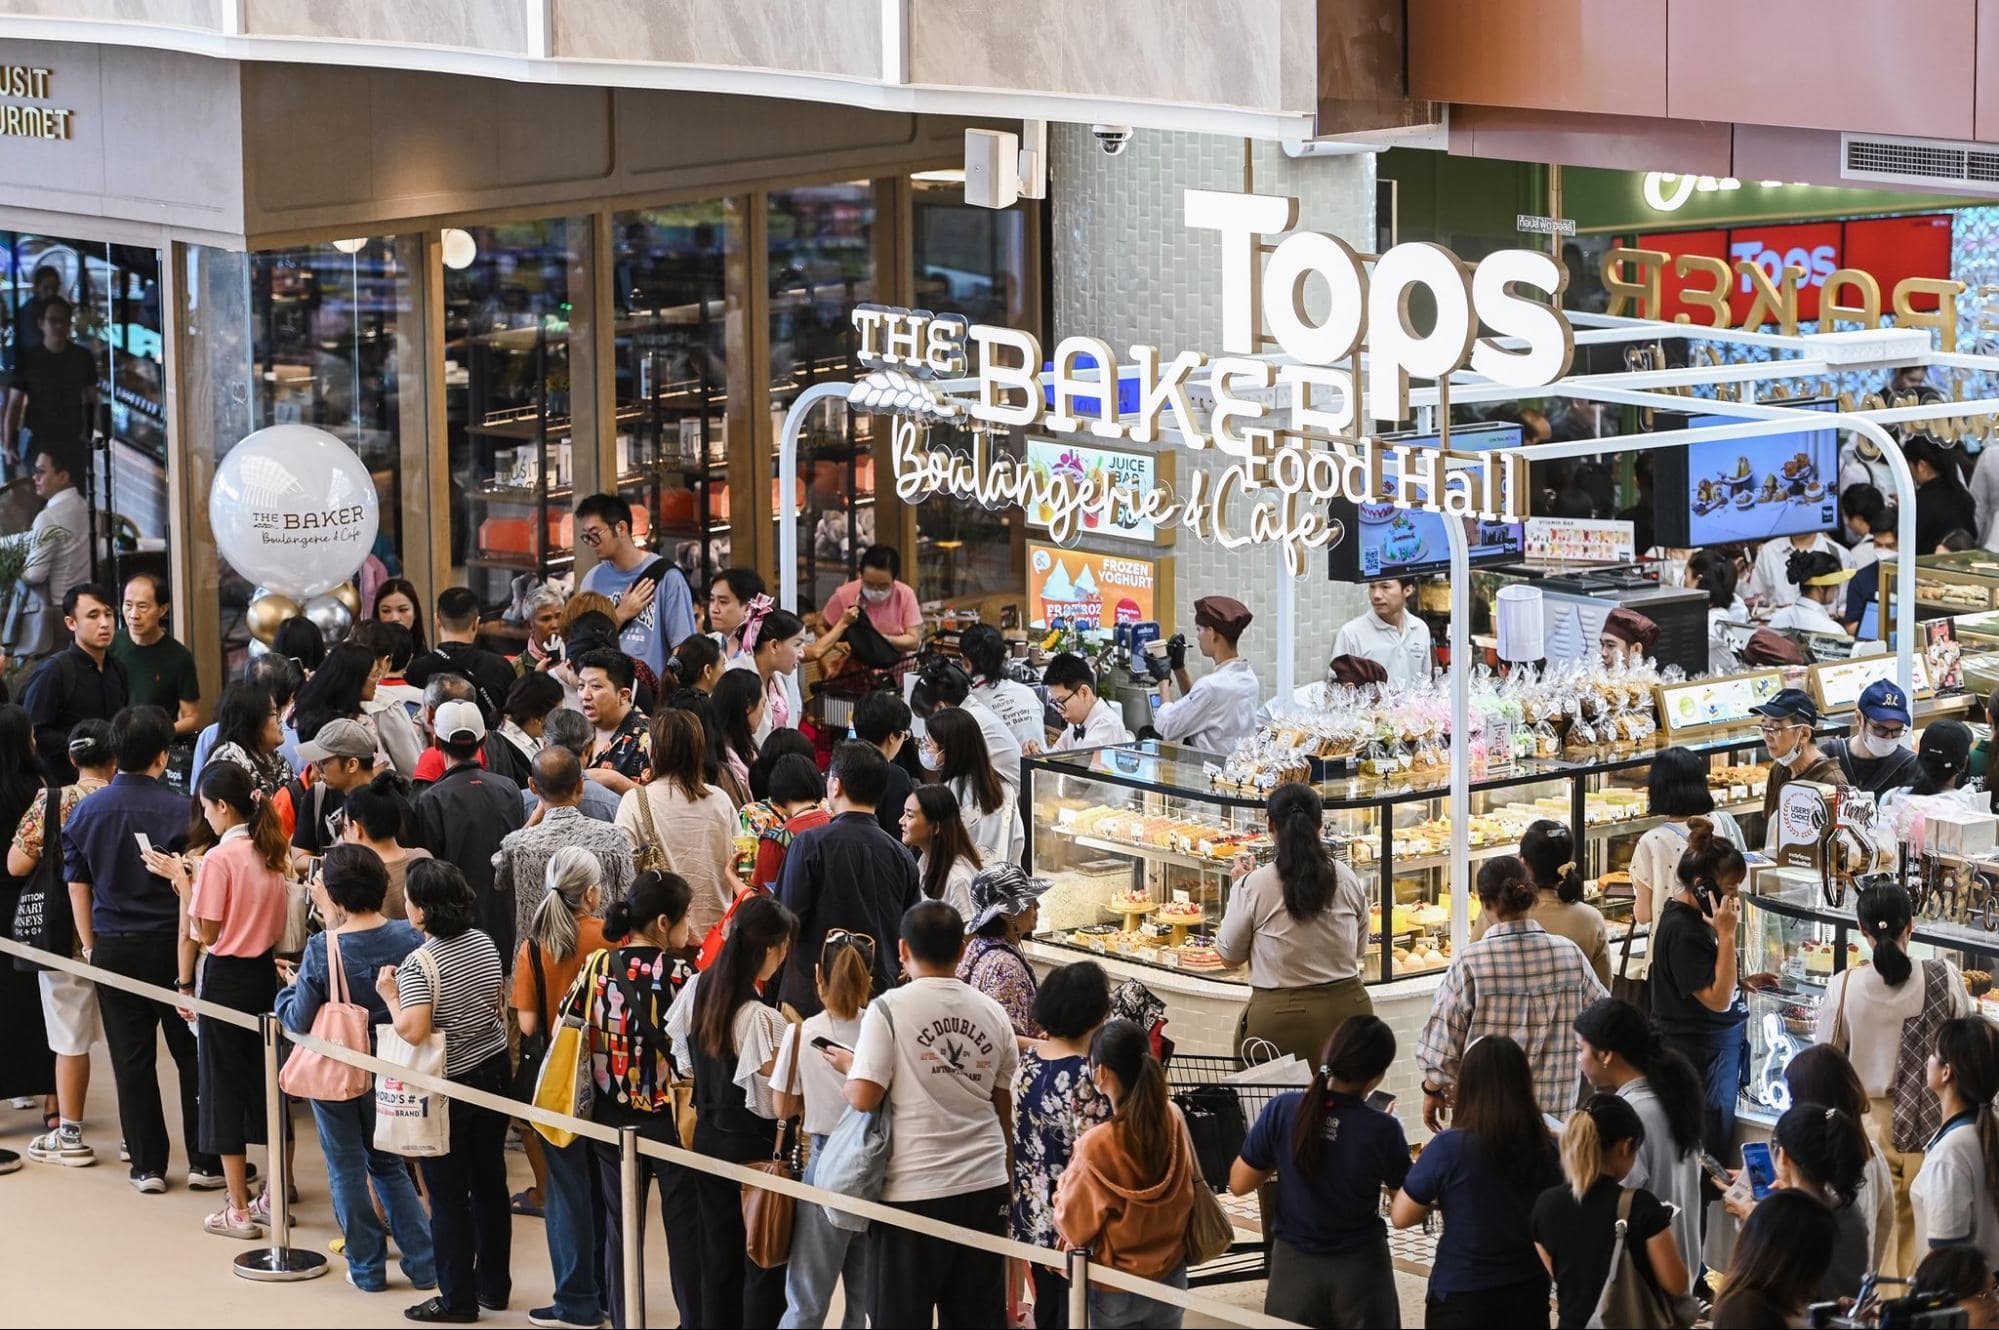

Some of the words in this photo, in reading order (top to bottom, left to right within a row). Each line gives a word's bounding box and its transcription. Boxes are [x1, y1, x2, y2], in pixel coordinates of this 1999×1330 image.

[1184, 188, 1572, 421] Tops
[852, 308, 964, 373] THE
[969, 323, 1358, 460] BAKER
[1109, 456, 1145, 473] JUICE
[1240, 426, 1383, 506] Food
[1392, 445, 1524, 524] Hall
[891, 414, 1182, 543] Boulangerie
[253, 512, 279, 523] THE
[283, 505, 364, 529] BAKER
[262, 532, 331, 548] Boulangerie
[1103, 559, 1149, 577] FROZEN
[1098, 571, 1153, 589] YOGHURT
[1790, 805, 1811, 814] USERS
[917, 1028, 935, 1047] CC
[932, 1017, 986, 1046] DOUBLE
[419, 1096, 428, 1118] 1
